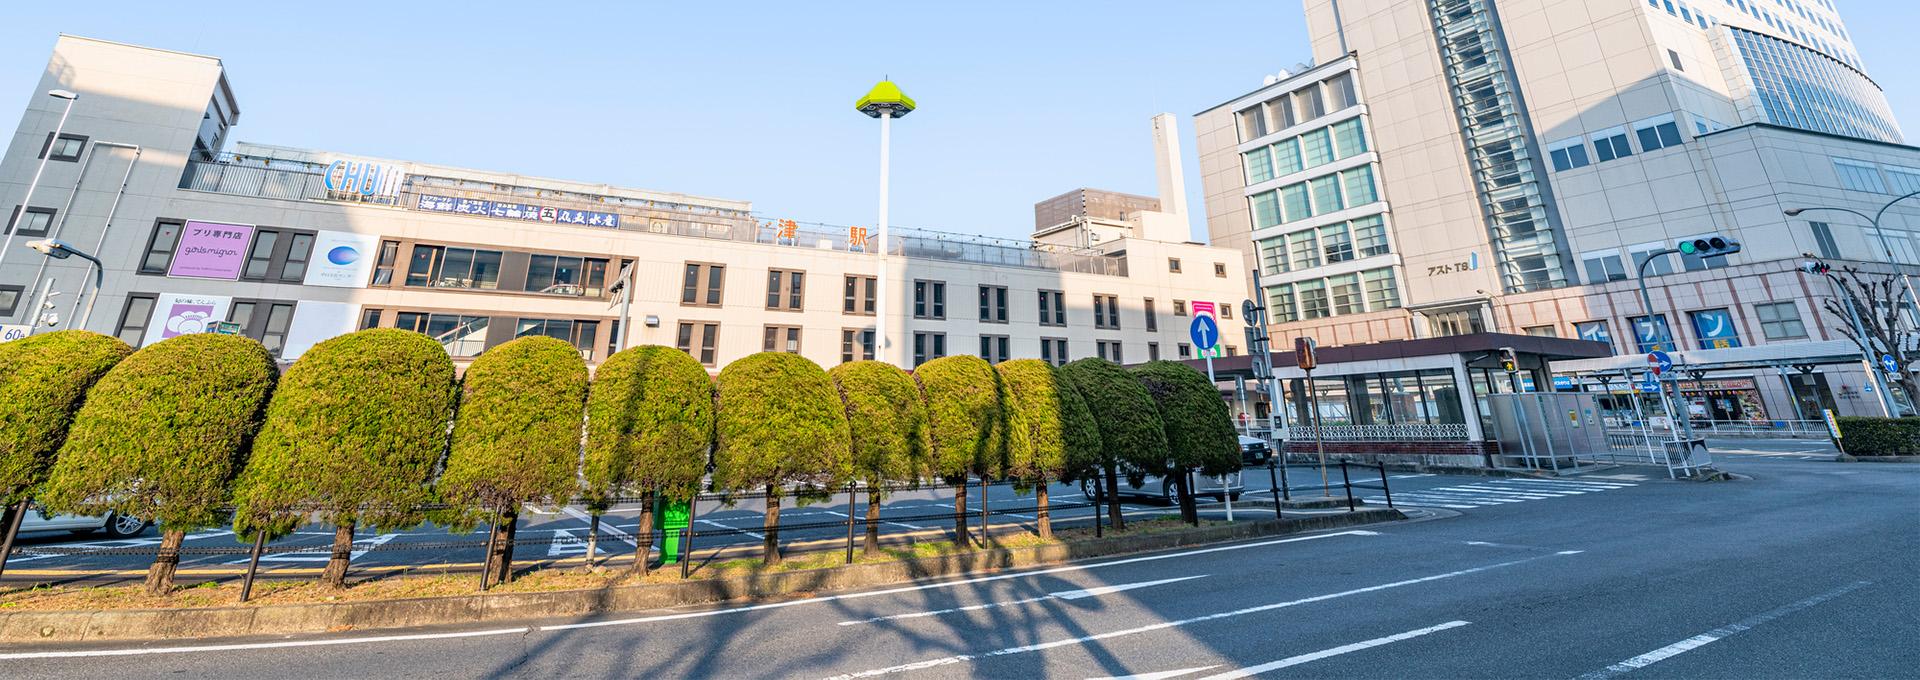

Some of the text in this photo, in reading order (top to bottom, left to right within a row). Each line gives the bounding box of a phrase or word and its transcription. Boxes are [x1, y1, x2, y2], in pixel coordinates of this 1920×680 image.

[778, 218, 867, 247] 津 駅
[1427, 264, 1452, 277] アスト
